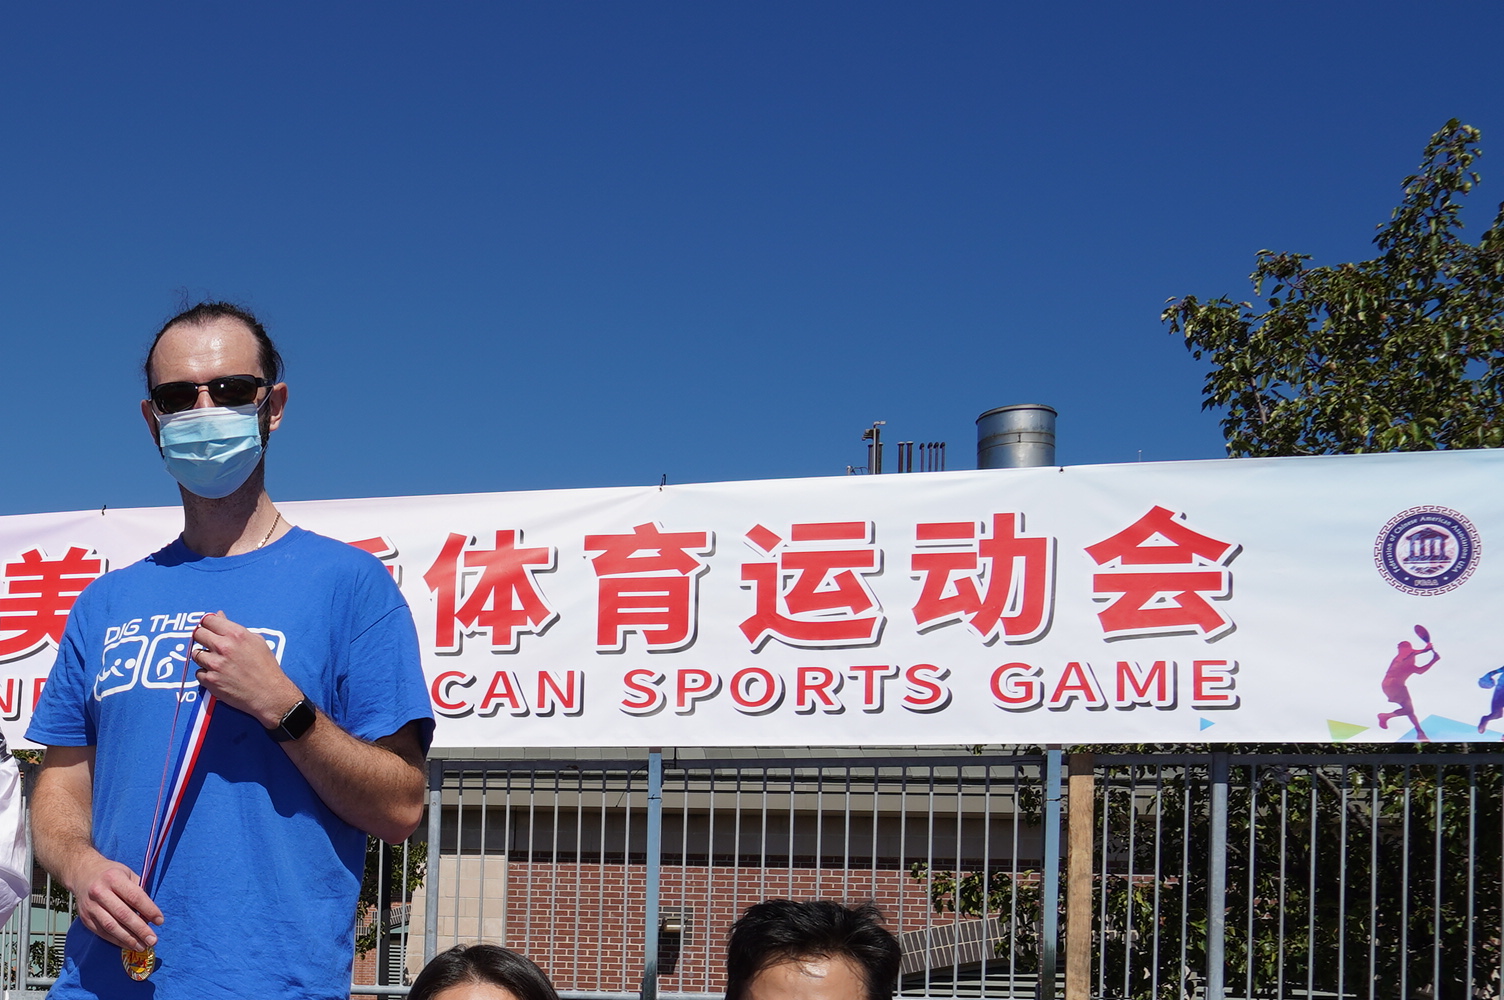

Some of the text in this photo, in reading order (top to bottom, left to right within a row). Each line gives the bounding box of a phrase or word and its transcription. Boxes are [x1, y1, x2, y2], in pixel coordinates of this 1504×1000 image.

[103, 618, 143, 646] DIG
[620, 662, 949, 715] SPORTS
[988, 659, 1240, 712] GAME
